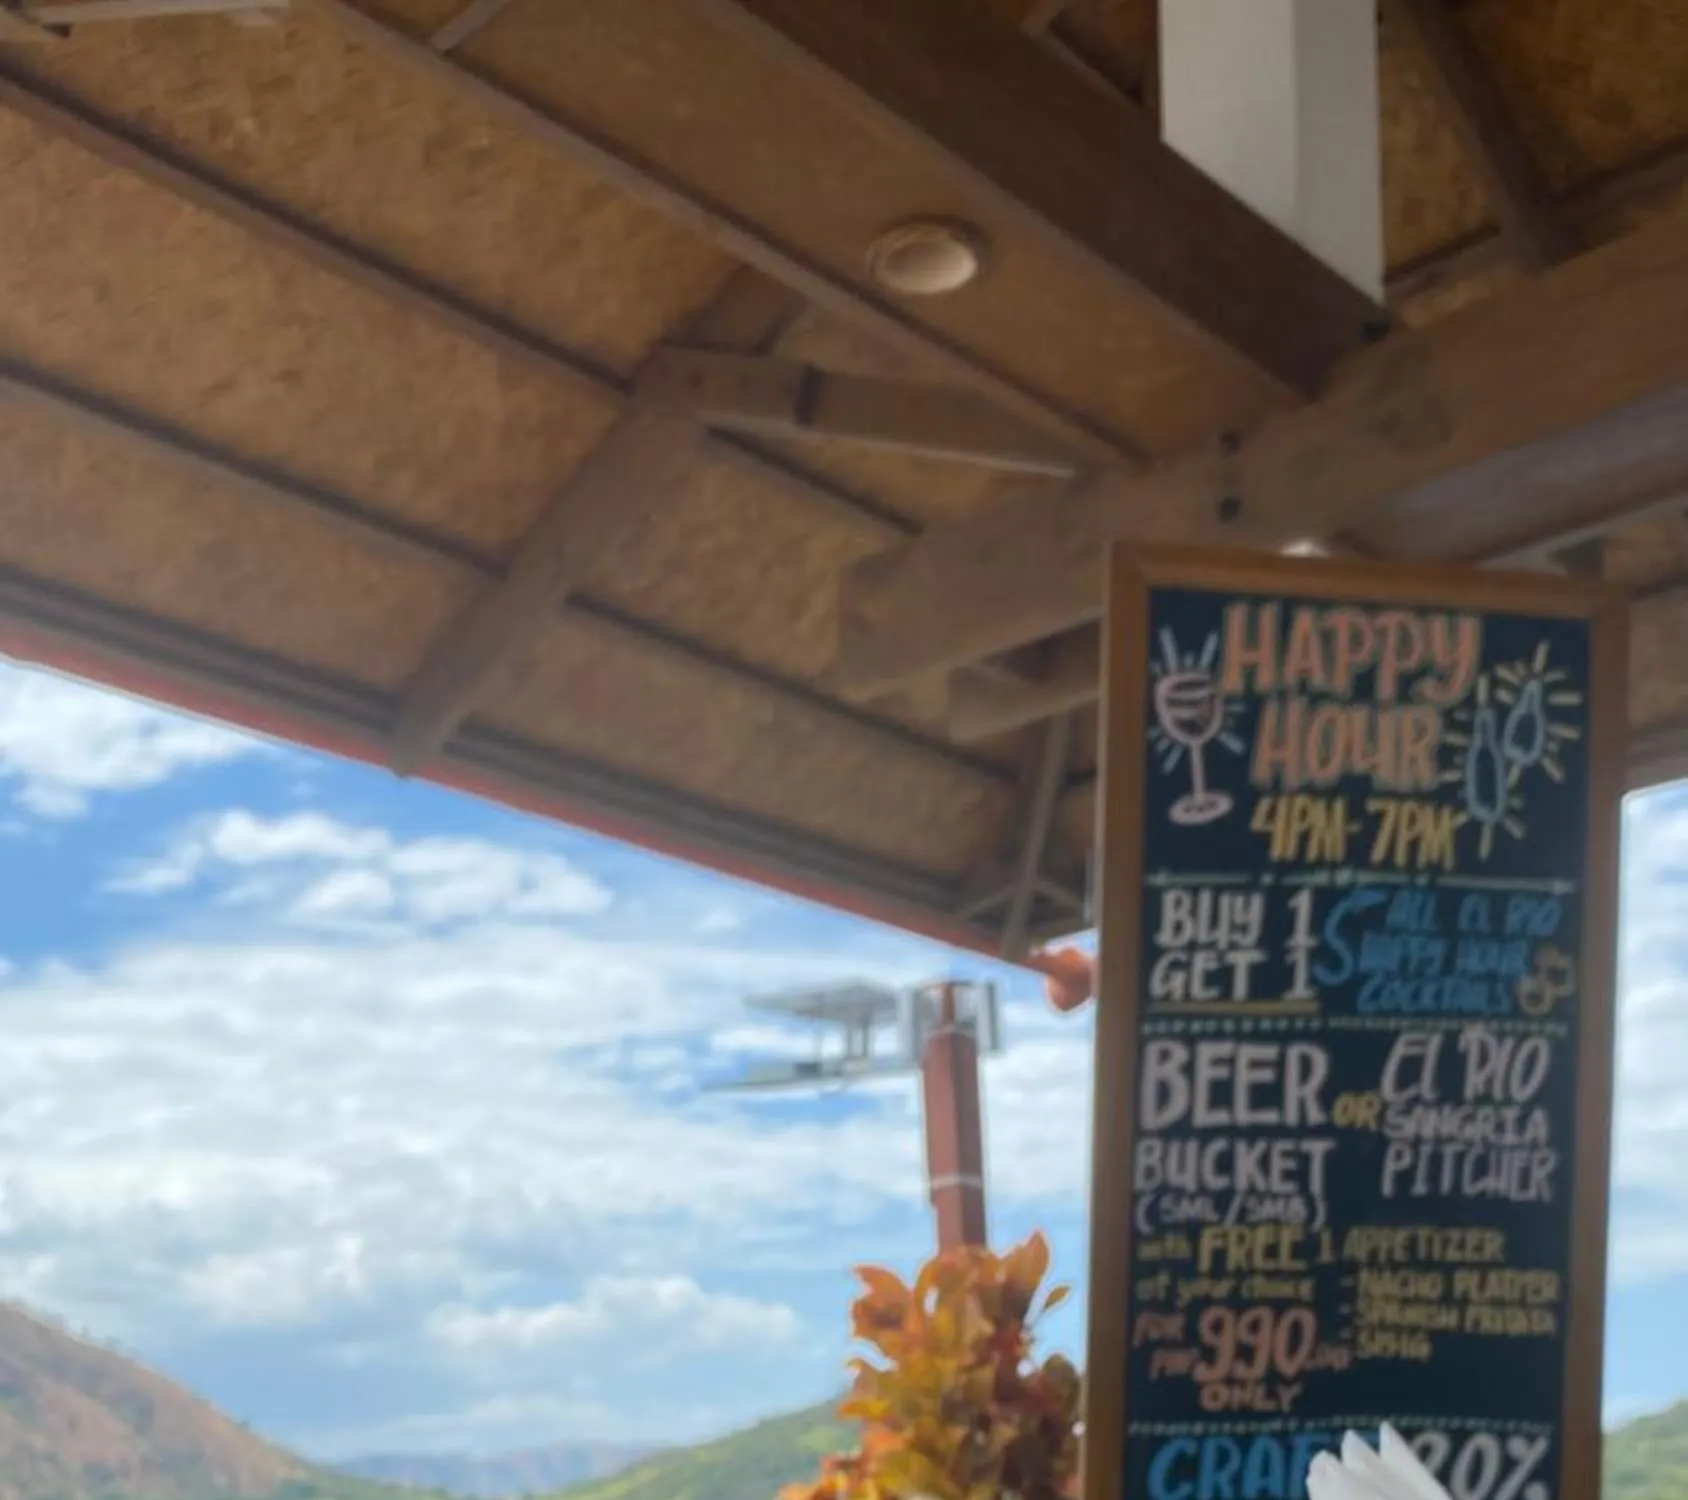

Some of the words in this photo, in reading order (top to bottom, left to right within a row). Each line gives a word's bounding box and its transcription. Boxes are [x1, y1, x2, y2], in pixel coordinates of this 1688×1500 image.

[1221, 603, 1480, 702] HAPPY
[1250, 699, 1441, 790] HOUR
[1154, 889, 1265, 951] BUY
[1286, 888, 1319, 949] 1
[1149, 948, 1268, 1001] GET
[1285, 948, 1317, 1001] 1
[1359, 931, 1450, 977] HAPPY
[1356, 972, 1512, 1014] COCKTAILS
[1139, 1039, 1328, 1131] BEER
[1458, 1023, 1551, 1104] RIO
[1333, 1092, 1382, 1131] OR
[1383, 1103, 1547, 1147] SANGRIA
[1133, 1137, 1336, 1196] BUCKET
[1380, 1140, 1558, 1203] PITCHER
[1197, 1224, 1308, 1274] FREE
[1343, 1225, 1506, 1263] APPETIZER
[1199, 1382, 1303, 1413] ONLY
